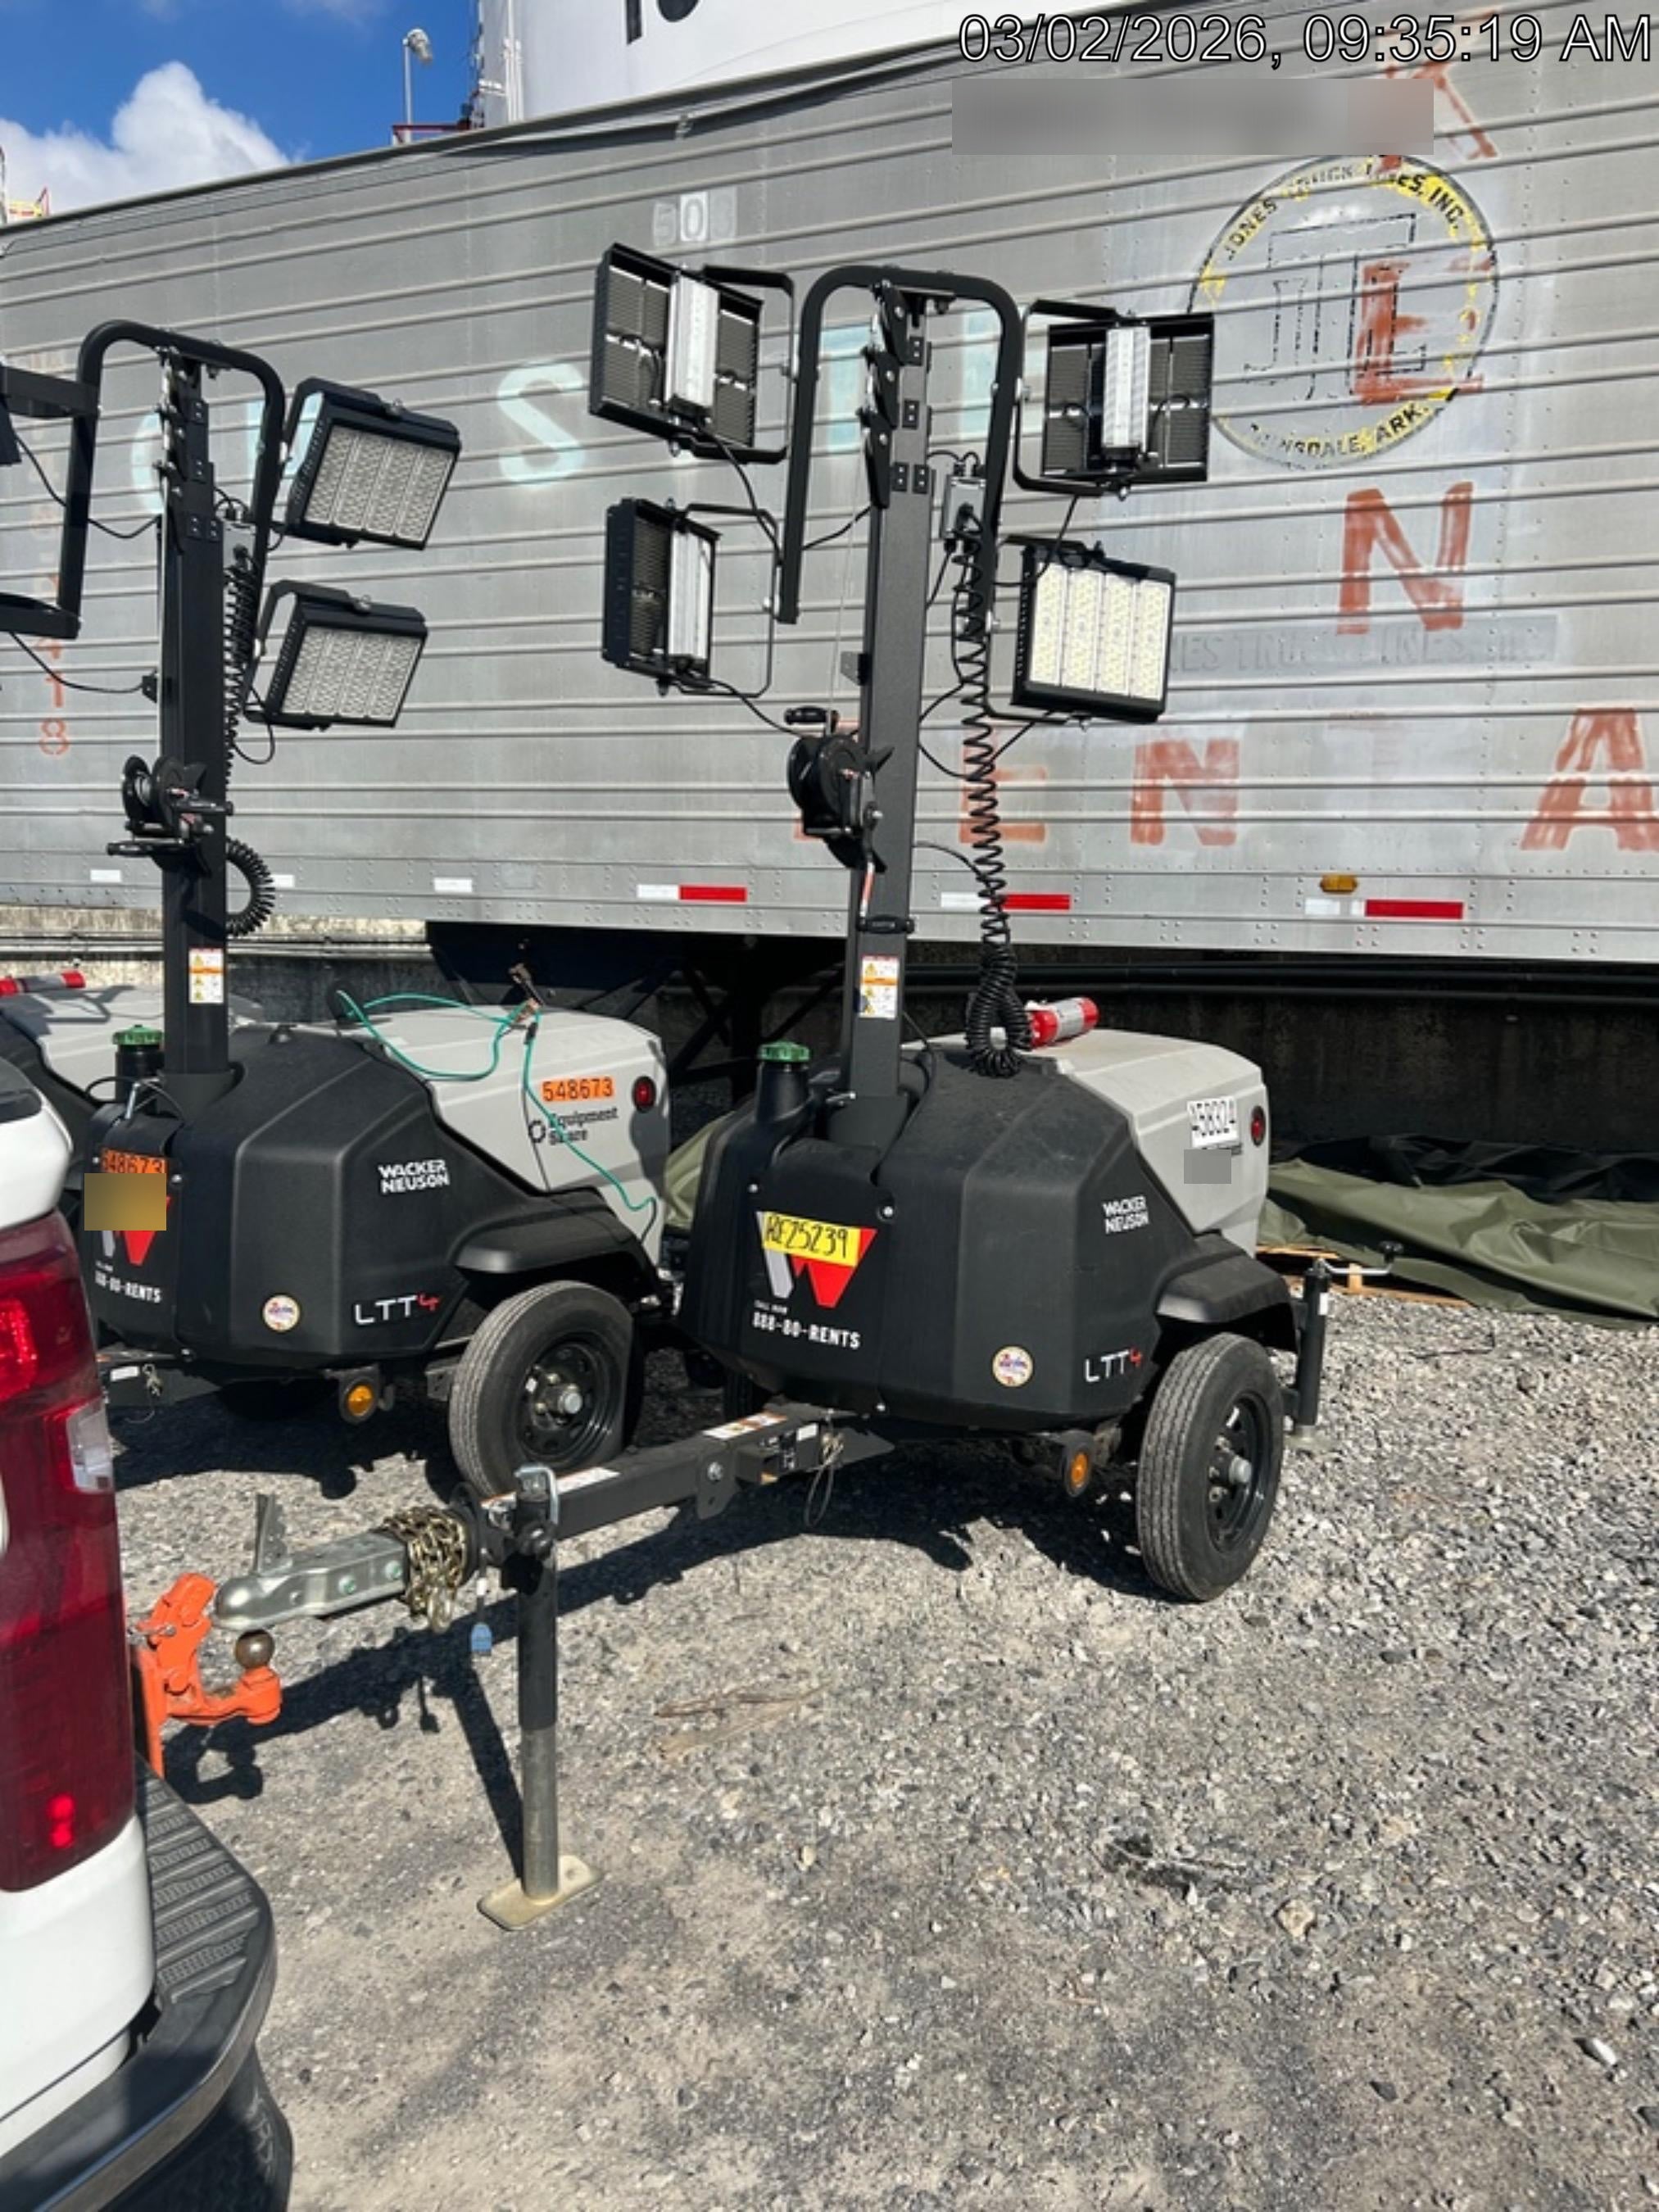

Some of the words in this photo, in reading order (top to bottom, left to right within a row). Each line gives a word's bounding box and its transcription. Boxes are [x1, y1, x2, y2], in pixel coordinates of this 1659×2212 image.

[542, 1076, 614, 1102] 548673
[548, 1130, 588, 1146] Sare
[378, 1158, 447, 1179] WACKER
[380, 1172, 451, 1194] NEUSON
[1103, 1194, 1147, 1217] WACKER
[1105, 1210, 1150, 1235] NEUSON
[764, 1215, 849, 1260] RE25239
[354, 1293, 440, 1326] LTT4
[752, 1310, 861, 1350] 888-80-RENTS
[1084, 1347, 1143, 1383] LTT4
